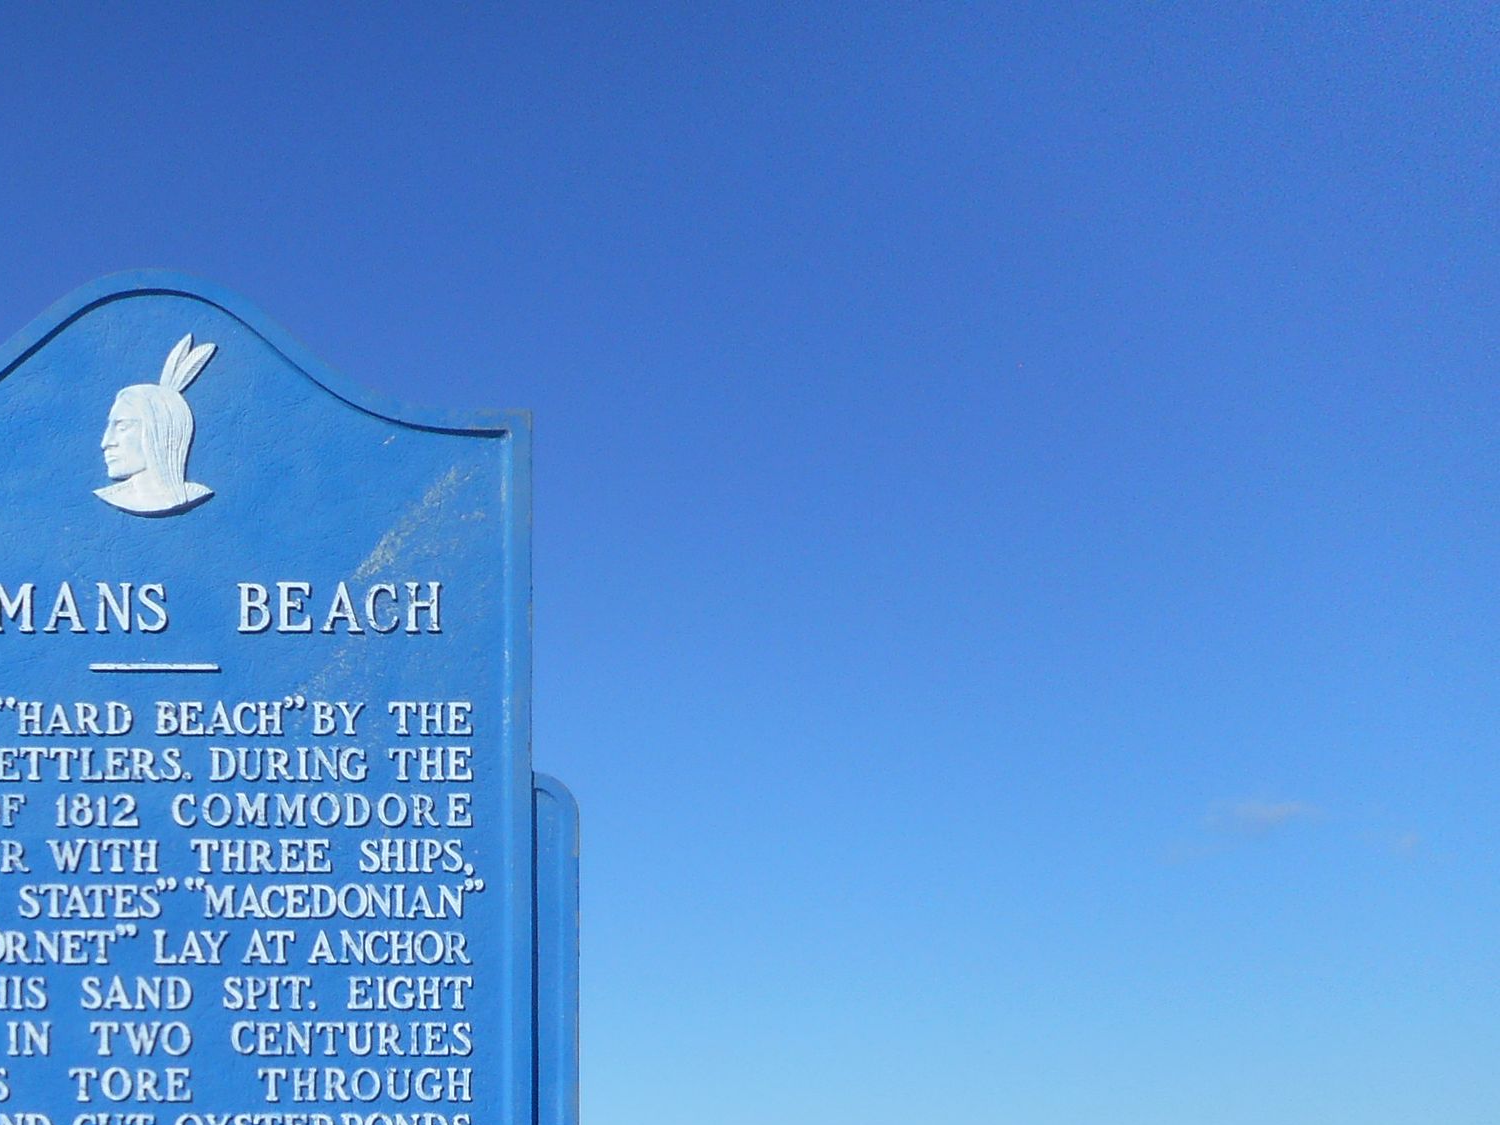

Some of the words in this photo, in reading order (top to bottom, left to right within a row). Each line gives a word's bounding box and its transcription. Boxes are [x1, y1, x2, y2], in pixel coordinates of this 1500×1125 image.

[237, 581, 440, 632] BEACH
[312, 700, 364, 735] BY
[388, 701, 472, 735] THE
[209, 746, 367, 781] DURING
[388, 746, 472, 781] THE
[55, 793, 139, 827] 1812
[171, 791, 472, 827] COMMODORE
[45, 838, 159, 873] WITH
[190, 838, 331, 873] THREE
[359, 838, 475, 876] SHIPS,
[153, 928, 228, 964] LAY
[242, 928, 295, 964] AT
[307, 929, 471, 964] ANCHOR
[80, 975, 192, 1010] SAND
[223, 975, 316, 1010] SPIT.
[347, 975, 472, 1010] EIGHT
[6, 1020, 50, 1056] IN
[89, 1020, 191, 1056] TWO
[231, 1020, 472, 1056] CENTURIES
[68, 1066, 191, 1102] TORE
[257, 1067, 472, 1102] THROUGH
